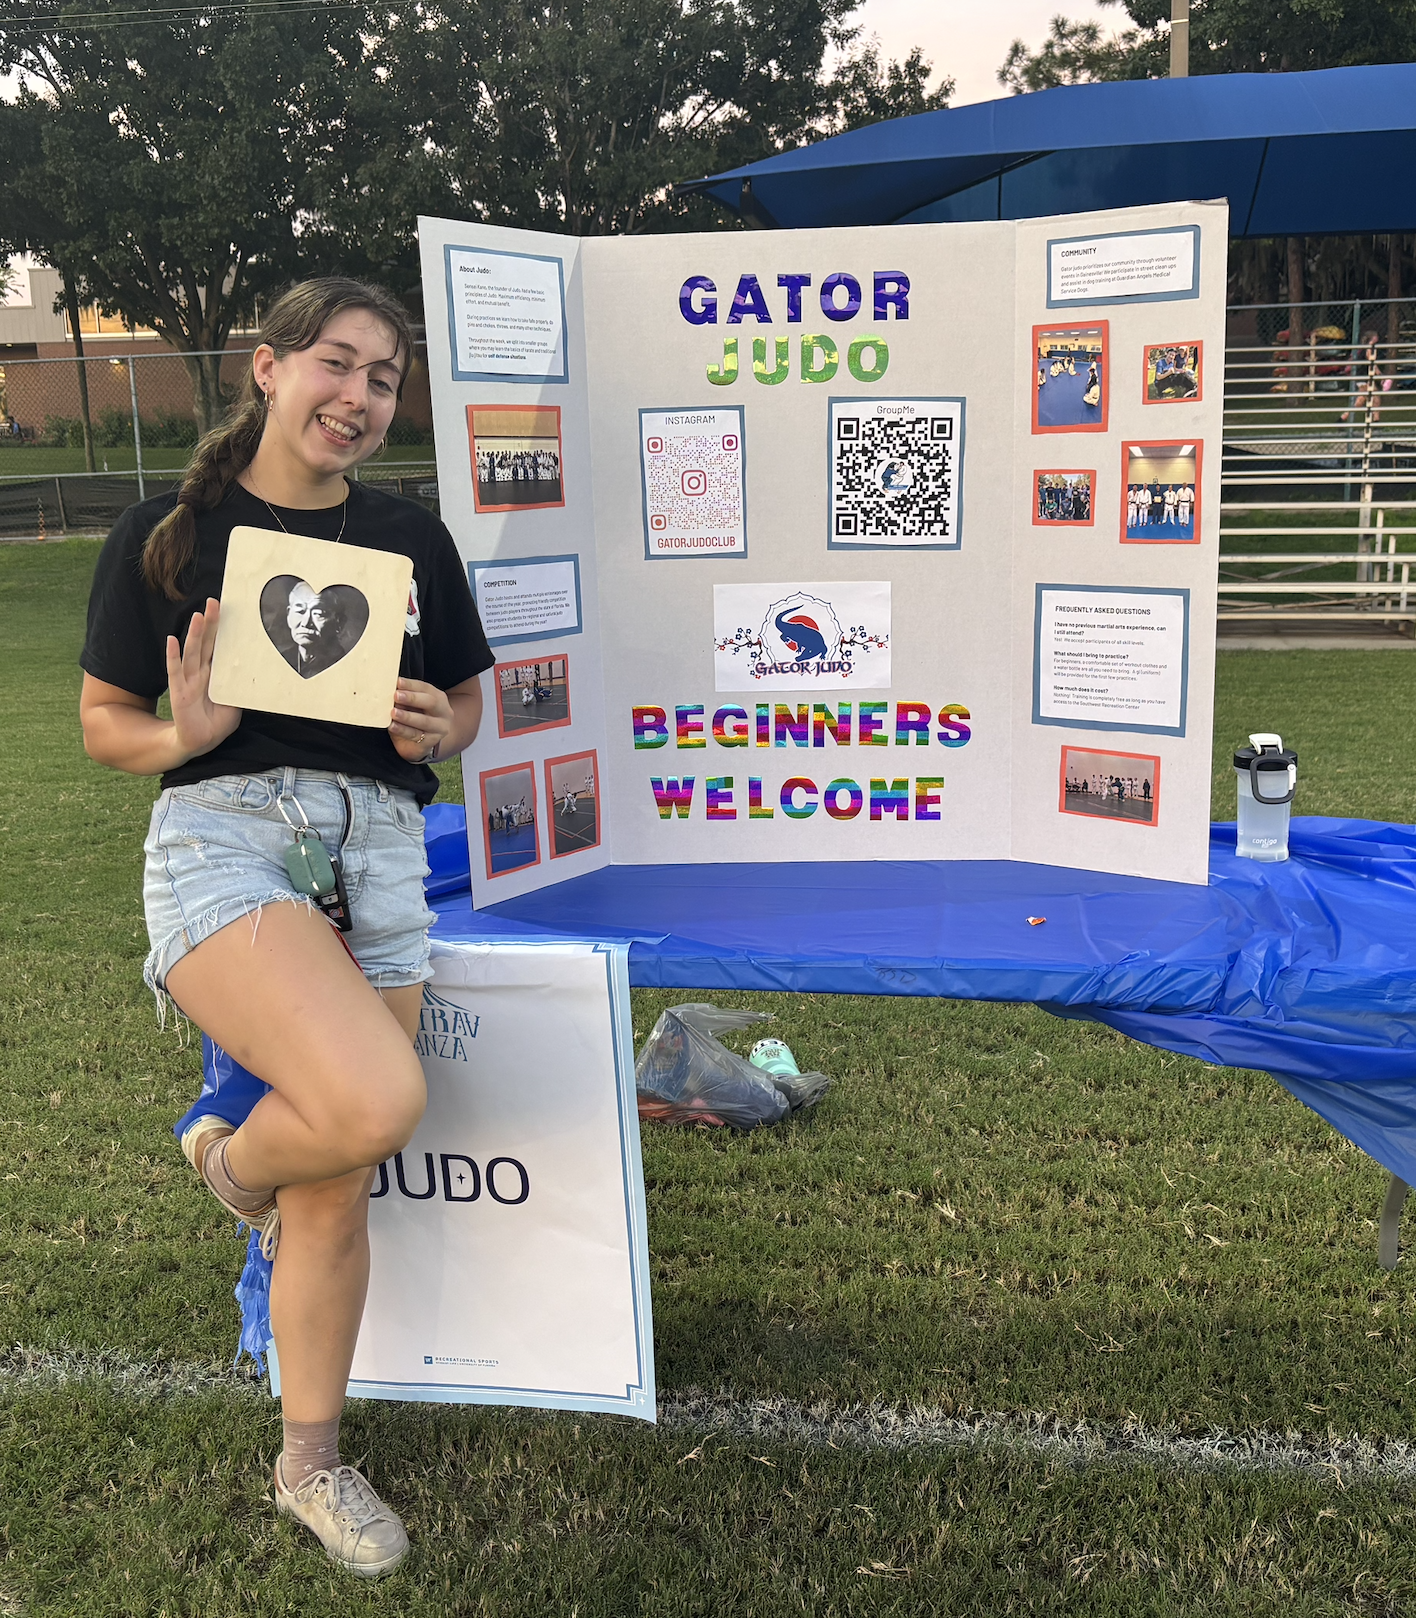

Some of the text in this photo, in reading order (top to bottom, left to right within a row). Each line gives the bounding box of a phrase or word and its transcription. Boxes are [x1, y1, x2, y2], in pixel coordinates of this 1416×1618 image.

[1061, 248, 1097, 257] COMMUNITY
[678, 270, 910, 325] GATOR
[706, 334, 889, 386] JUDO
[876, 406, 915, 416] GroupMe
[665, 415, 716, 426] INSTAGRAM
[657, 536, 736, 549] GATORJUDOCLUB
[755, 661, 852, 676] GATOR JUDO
[632, 700, 972, 749] BEGINNERS
[650, 776, 944, 821] WELCOME
[1252, 838, 1277, 846] contigo
[370, 1152, 529, 1204] JUDO
